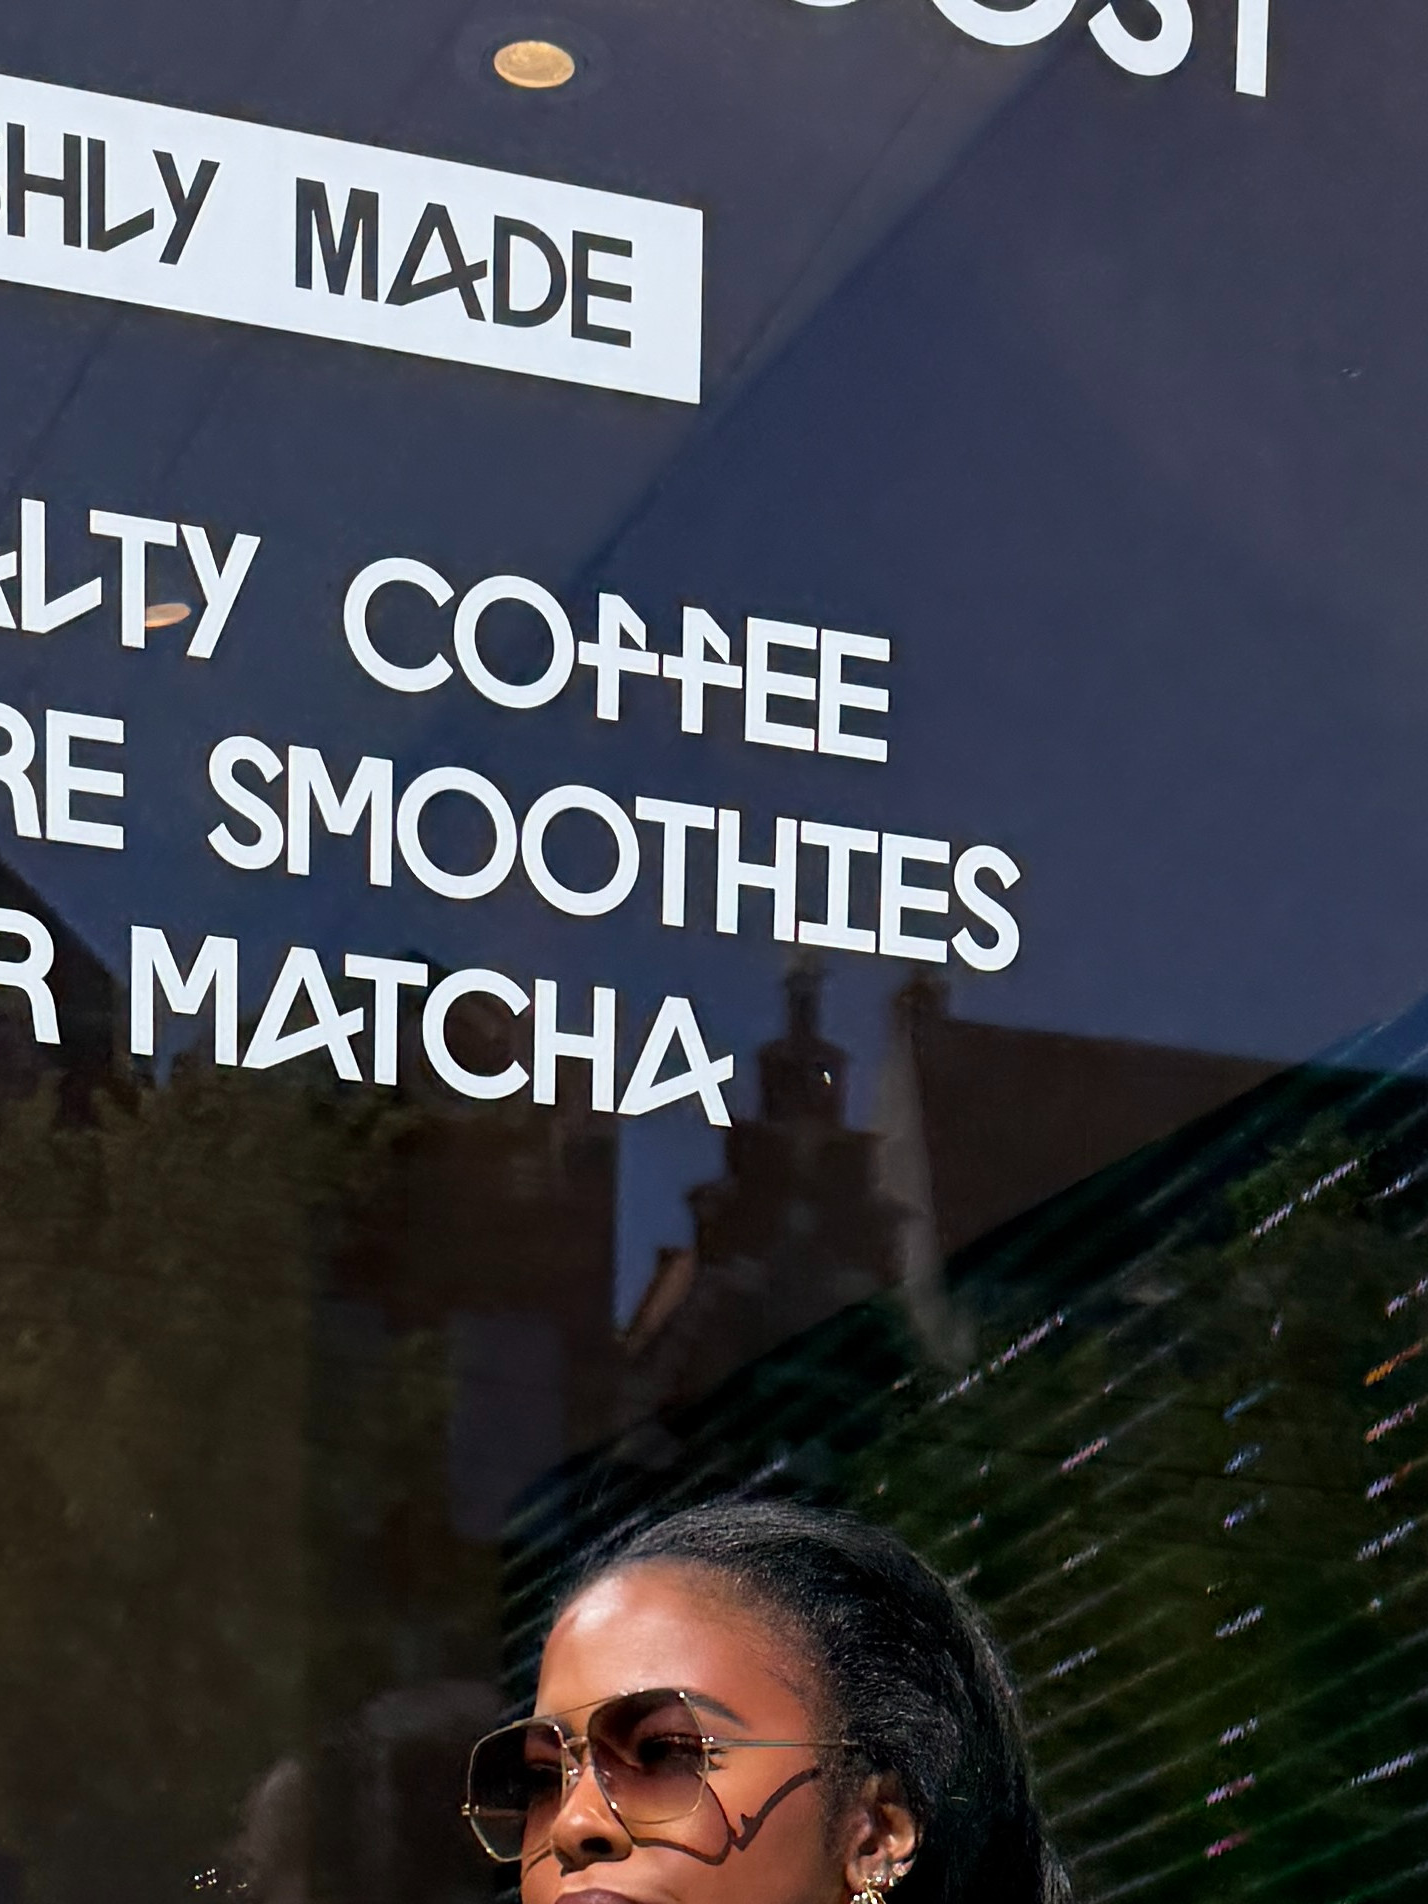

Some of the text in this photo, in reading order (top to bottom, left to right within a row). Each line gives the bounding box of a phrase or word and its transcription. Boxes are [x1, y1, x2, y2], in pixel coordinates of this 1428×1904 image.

[295, 177, 633, 349] MADE
[207, 735, 1021, 971] SMOOTHIES
[130, 925, 734, 1127] MATCHA
